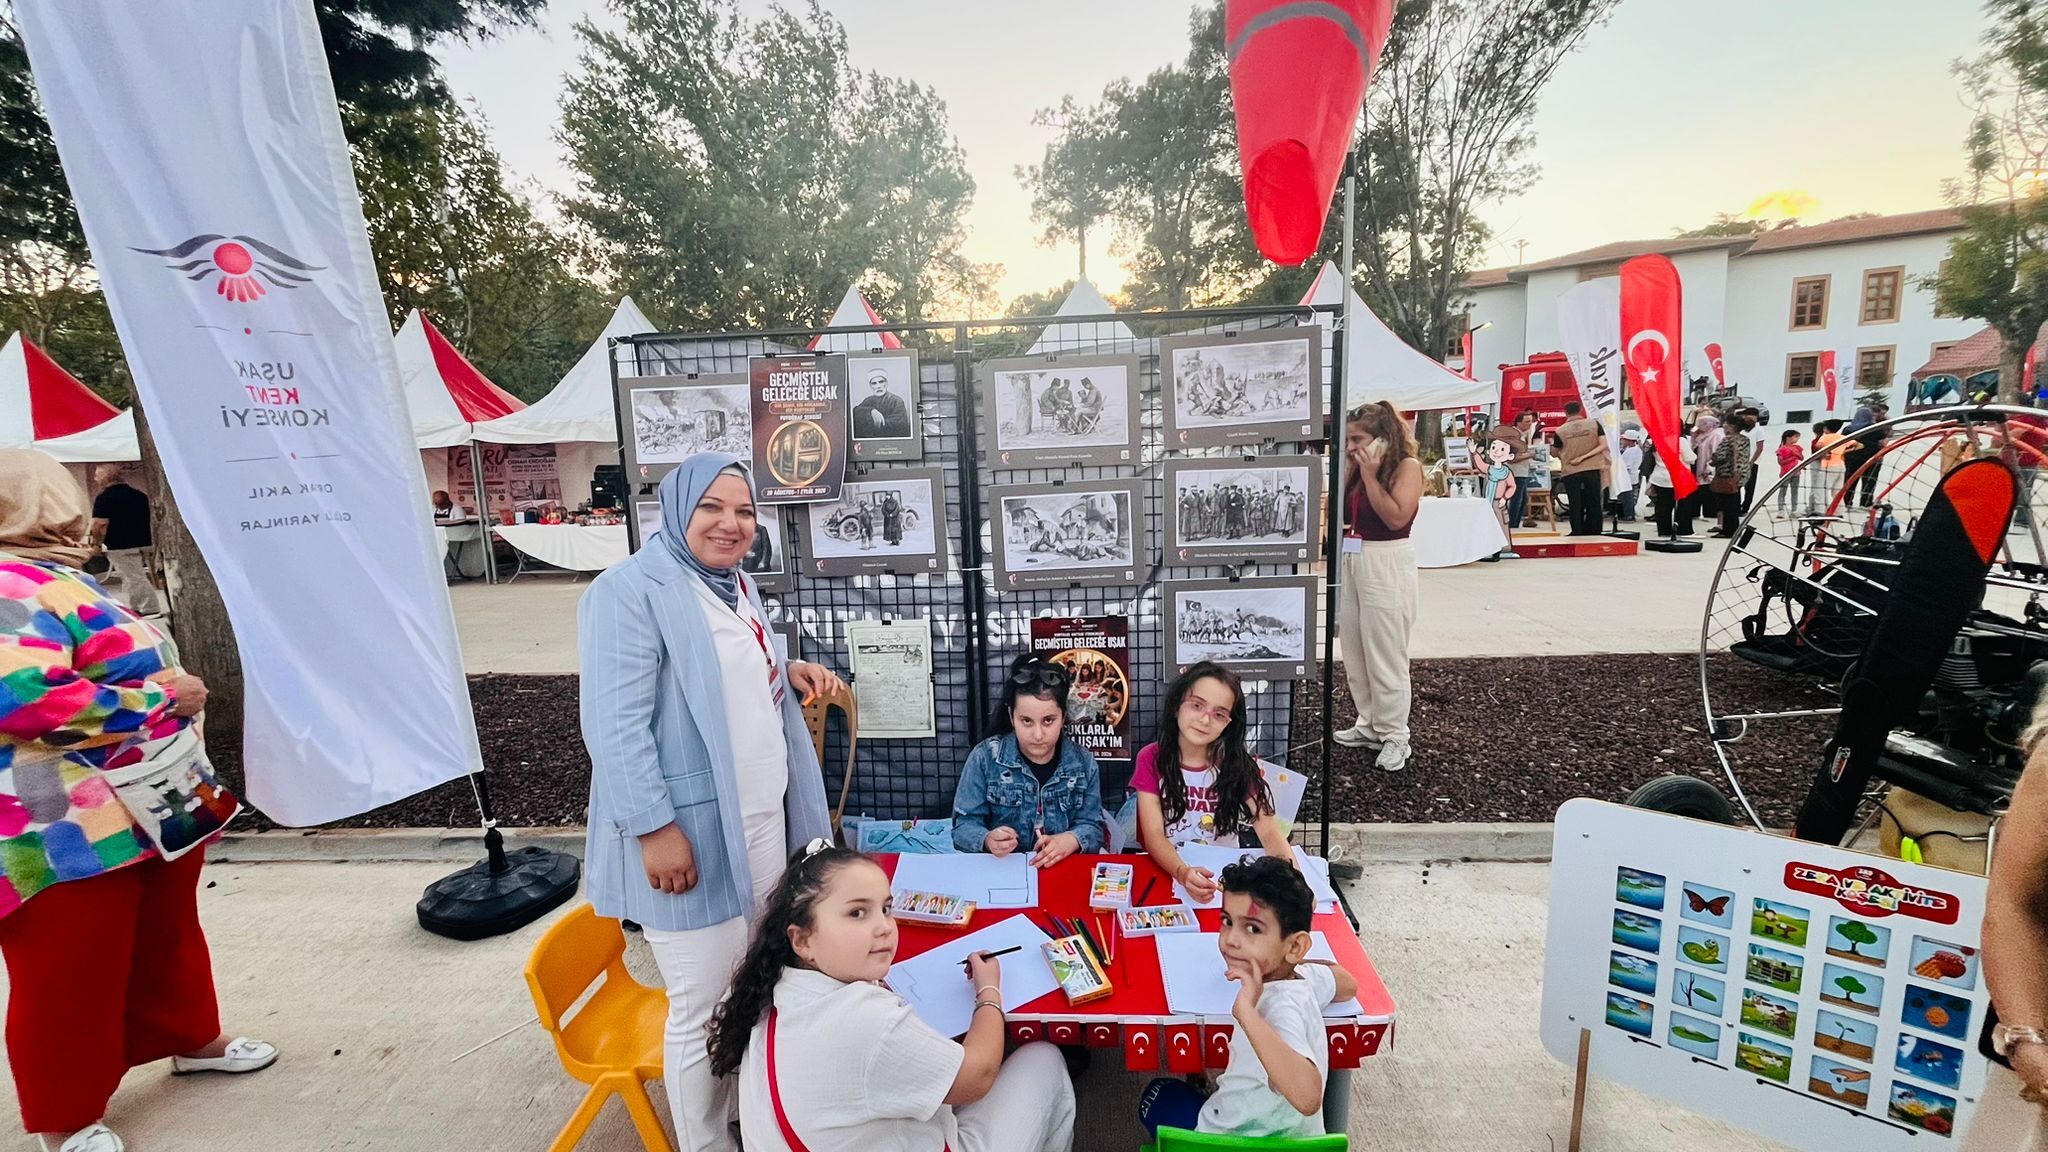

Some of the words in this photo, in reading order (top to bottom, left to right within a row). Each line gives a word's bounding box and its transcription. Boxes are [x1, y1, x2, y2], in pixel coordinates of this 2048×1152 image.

[769, 371, 829, 387] GEÇMİŞTEN
[812, 385, 838, 401] UŞAK
[456, 449, 504, 467] ERU
[1034, 637, 1073, 650] GEÇMİŞTEN
[1074, 636, 1106, 649] GELECEĞE
[1107, 636, 1126, 648] UŞAK
[1066, 724, 1115, 735] UKLARLA
[1793, 868, 1839, 887] ZEKA
